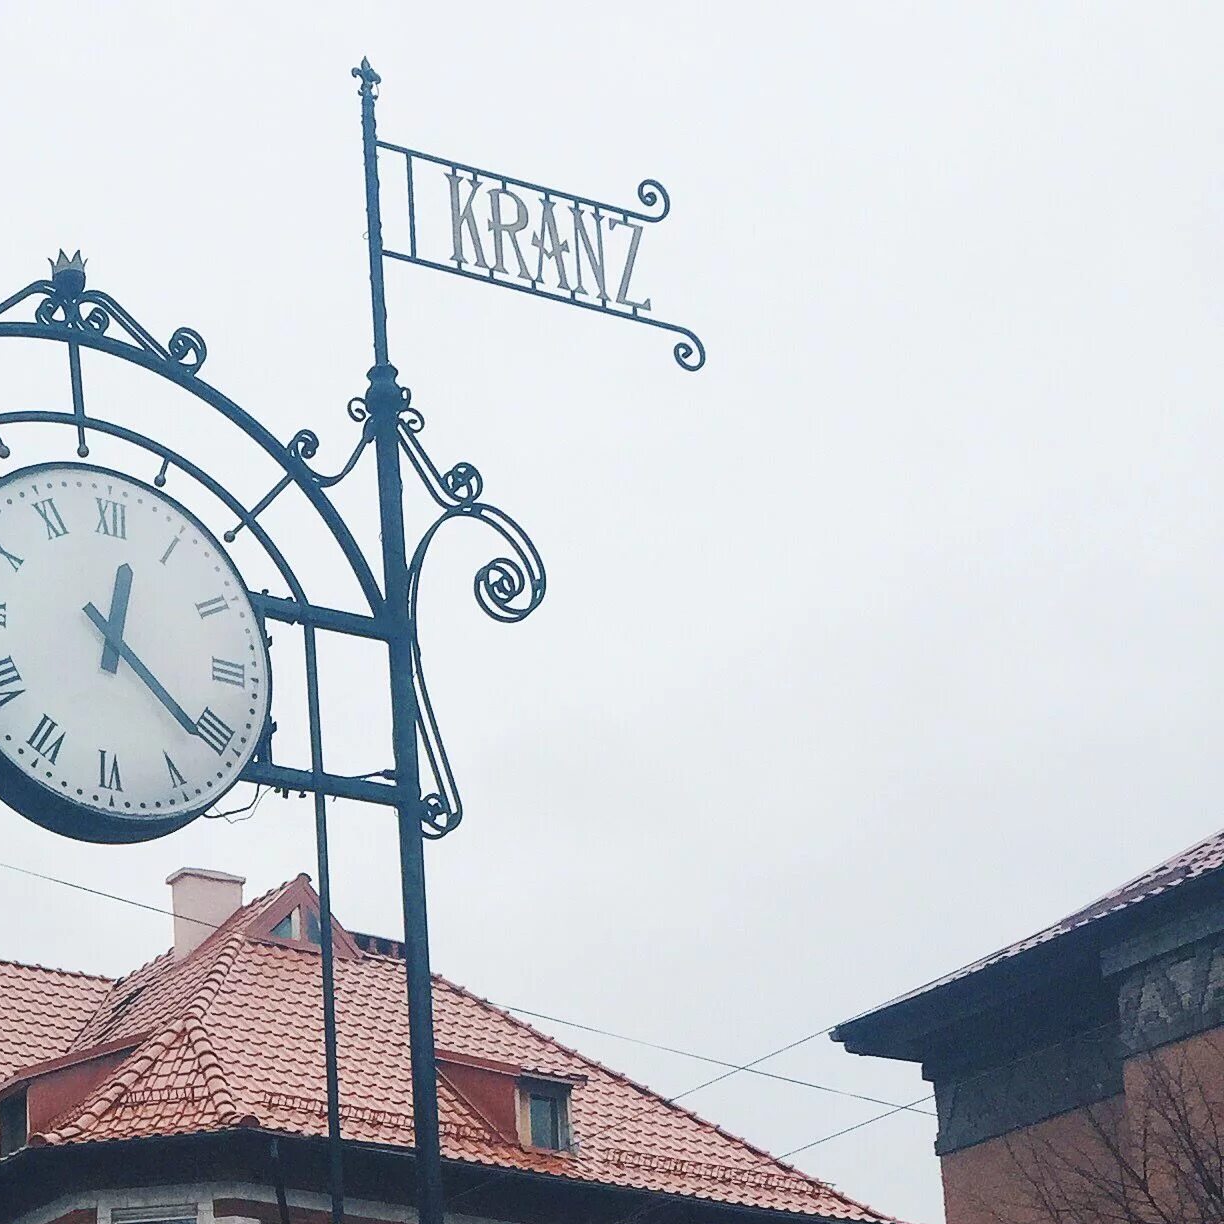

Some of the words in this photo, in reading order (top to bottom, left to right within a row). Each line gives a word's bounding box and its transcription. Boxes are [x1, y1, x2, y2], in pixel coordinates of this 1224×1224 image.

[444, 172, 651, 311] KRANZ
[31, 497, 70, 541] XI
[94, 497, 127, 540] XII
[158, 536, 181, 565] I
[194, 594, 230, 620] II
[211, 656, 246, 688] III
[25, 712, 67, 766] VII
[97, 749, 124, 793] VI
[162, 749, 188, 788] V
